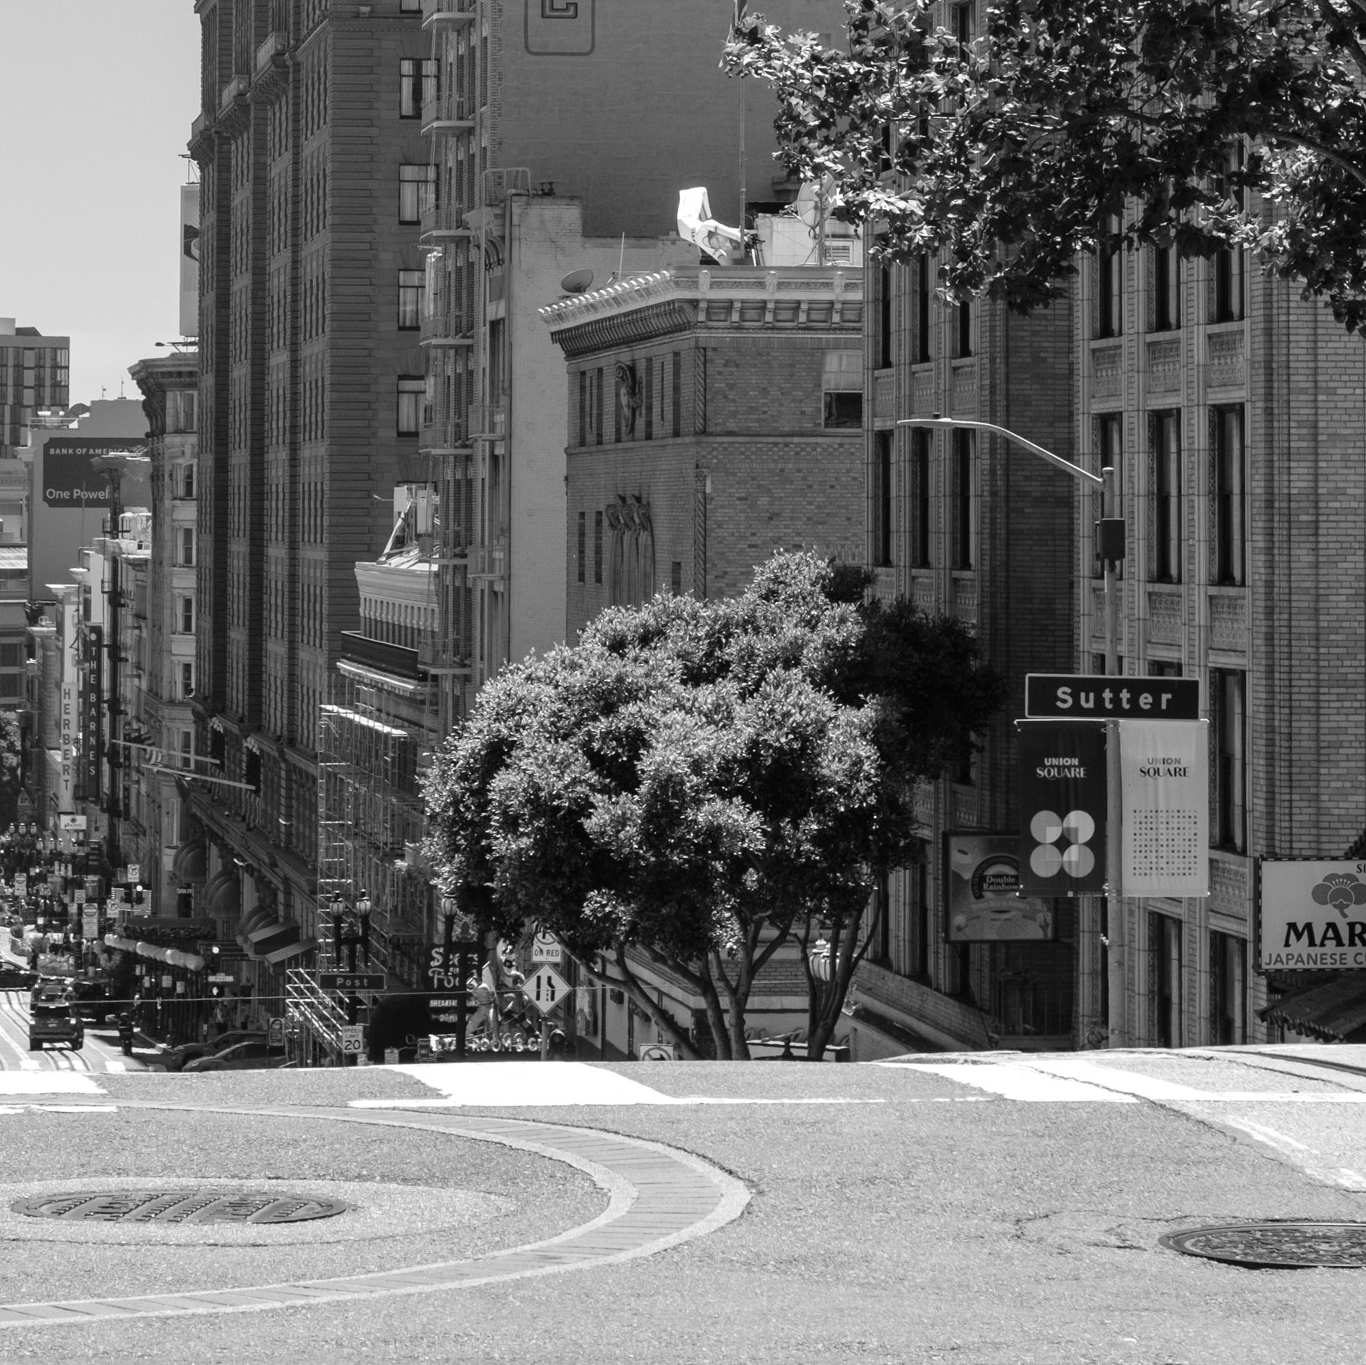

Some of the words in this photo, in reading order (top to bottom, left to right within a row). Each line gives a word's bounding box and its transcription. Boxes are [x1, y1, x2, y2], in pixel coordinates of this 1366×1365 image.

[88, 447, 130, 455] AMERICA
[45, 488, 71, 499] One
[73, 484, 110, 500] Powel
[1055, 686, 1173, 711] Sutter
[62, 687, 72, 791] HERBERT
[89, 693, 97, 776] BARNES
[1044, 757, 1079, 766] UNION
[1147, 757, 1182, 766] UNION
[1036, 767, 1087, 781] SQUARE
[1139, 767, 1190, 781] SQUARE
[985, 875, 1016, 884] Double
[982, 883, 1019, 892] Rainbow
[534, 949, 544, 957] ON
[546, 949, 560, 957] RED
[1265, 952, 1348, 966] JAPANESE
[336, 977, 368, 987] Post
[429, 1000, 458, 1008] BREAKFA
[344, 1039, 361, 1051] 20
